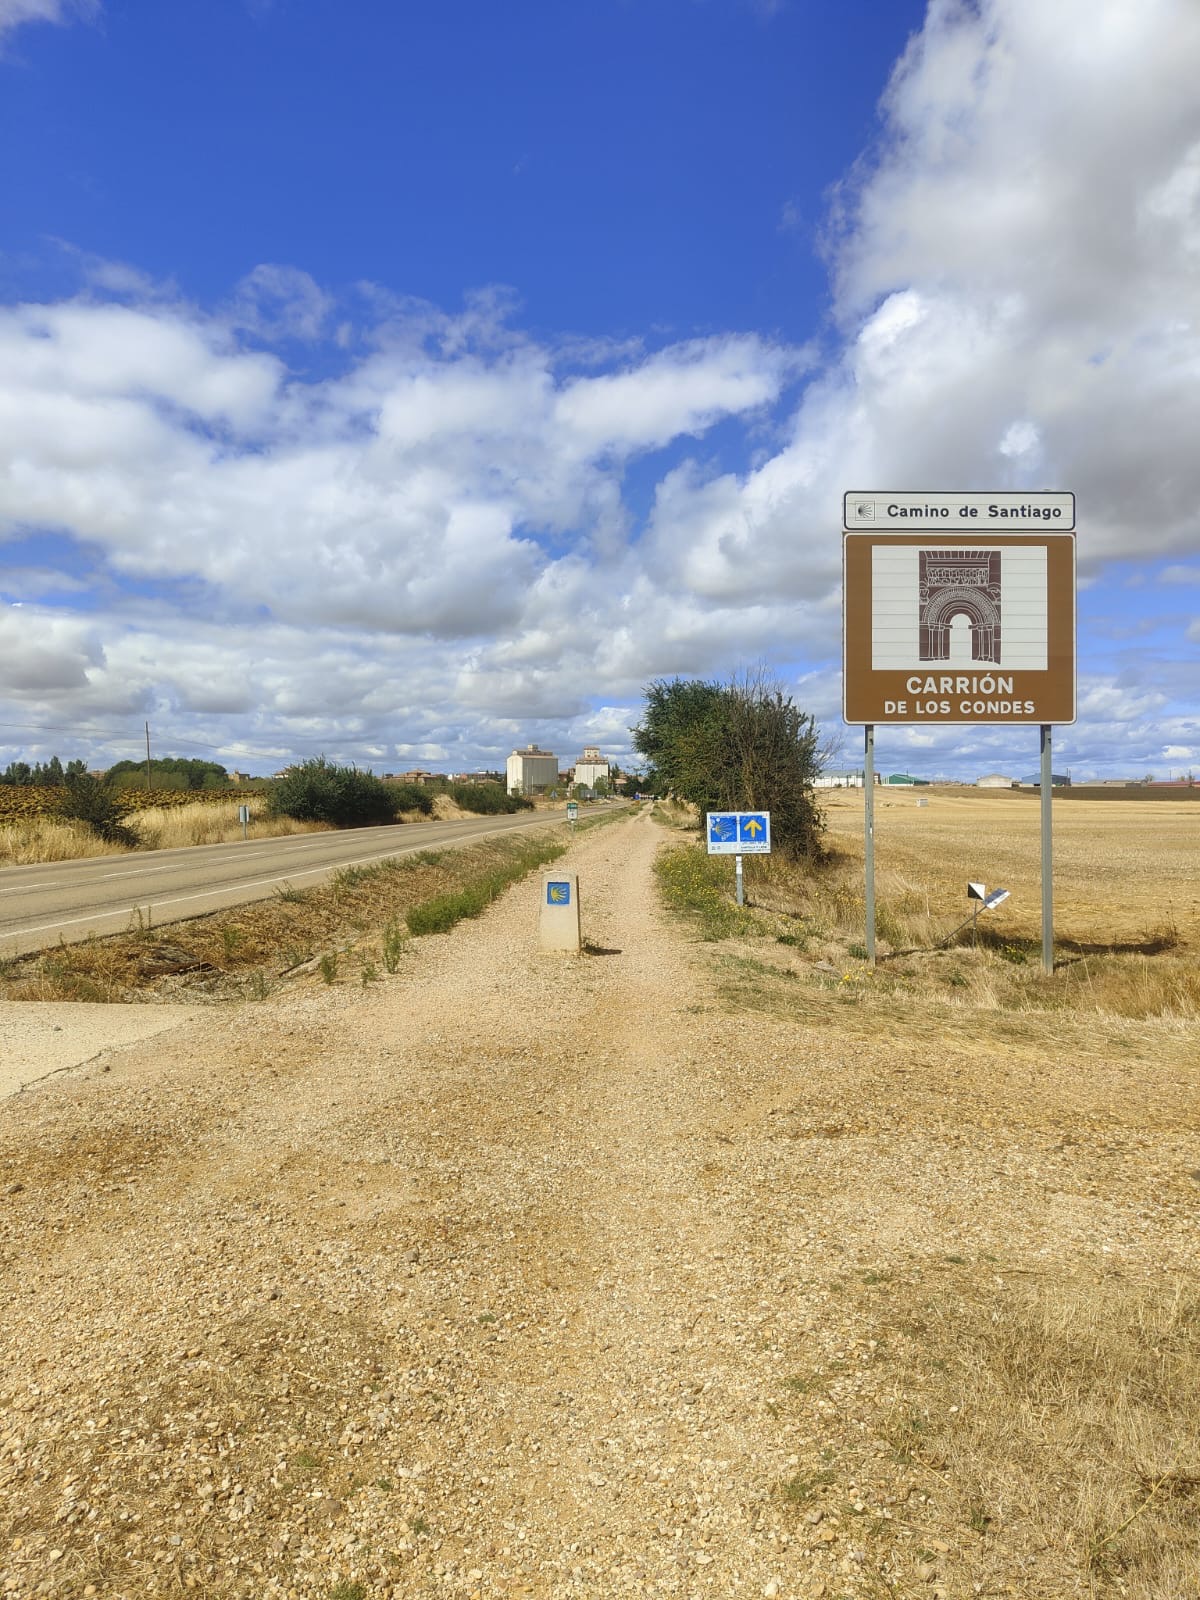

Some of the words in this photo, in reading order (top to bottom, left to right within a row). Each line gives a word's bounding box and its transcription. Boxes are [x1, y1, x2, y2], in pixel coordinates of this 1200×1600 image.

[887, 504, 950, 518] Camino
[959, 505, 978, 518] de
[988, 504, 1062, 520] Santiago
[906, 673, 1014, 695] CARRIÓN
[884, 701, 907, 714] DE
[916, 700, 951, 714] LOS
[959, 700, 1035, 714] CONDES
